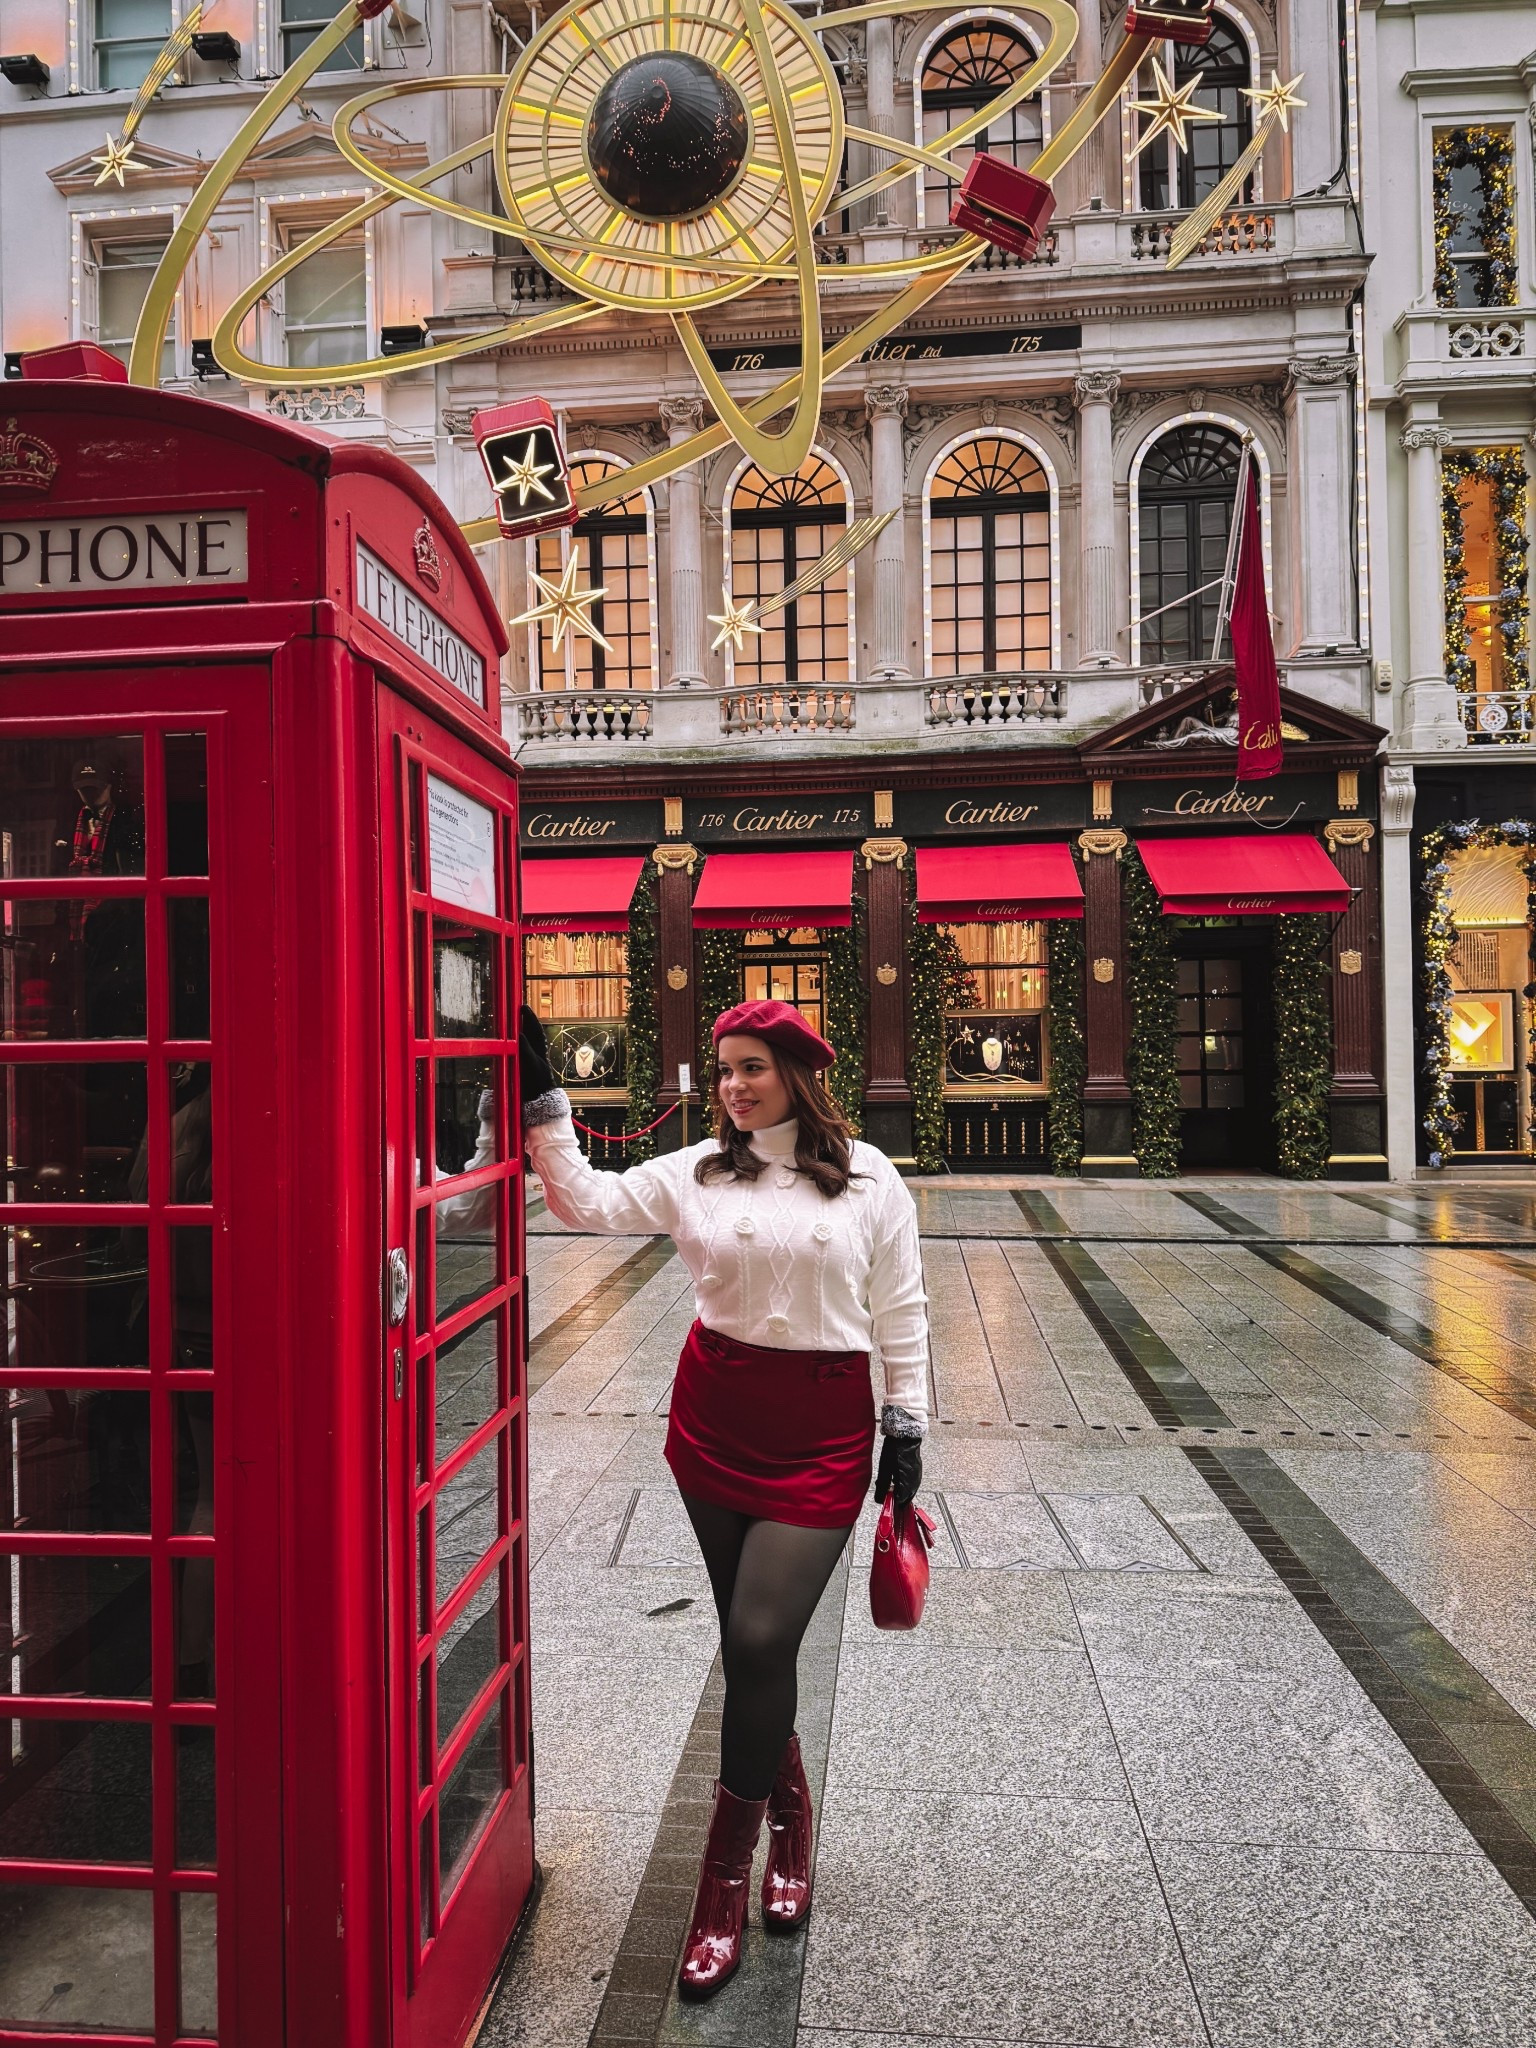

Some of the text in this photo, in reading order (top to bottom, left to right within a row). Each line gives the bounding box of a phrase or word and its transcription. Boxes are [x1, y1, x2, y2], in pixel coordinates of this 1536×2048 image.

[731, 336, 1043, 371] 176 rtier Ltd 175
[357, 552, 480, 702] TELEPHONE
[945, 800, 1039, 824] Cartier
[1174, 789, 1274, 815] Cartier
[527, 813, 616, 838] Cartier
[698, 807, 861, 831] 176 Cartier 175
[977, 902, 1023, 917] Cartier
[1227, 897, 1276, 910] Cartier
[529, 915, 573, 928] Cartier
[749, 910, 795, 925] Cartier
